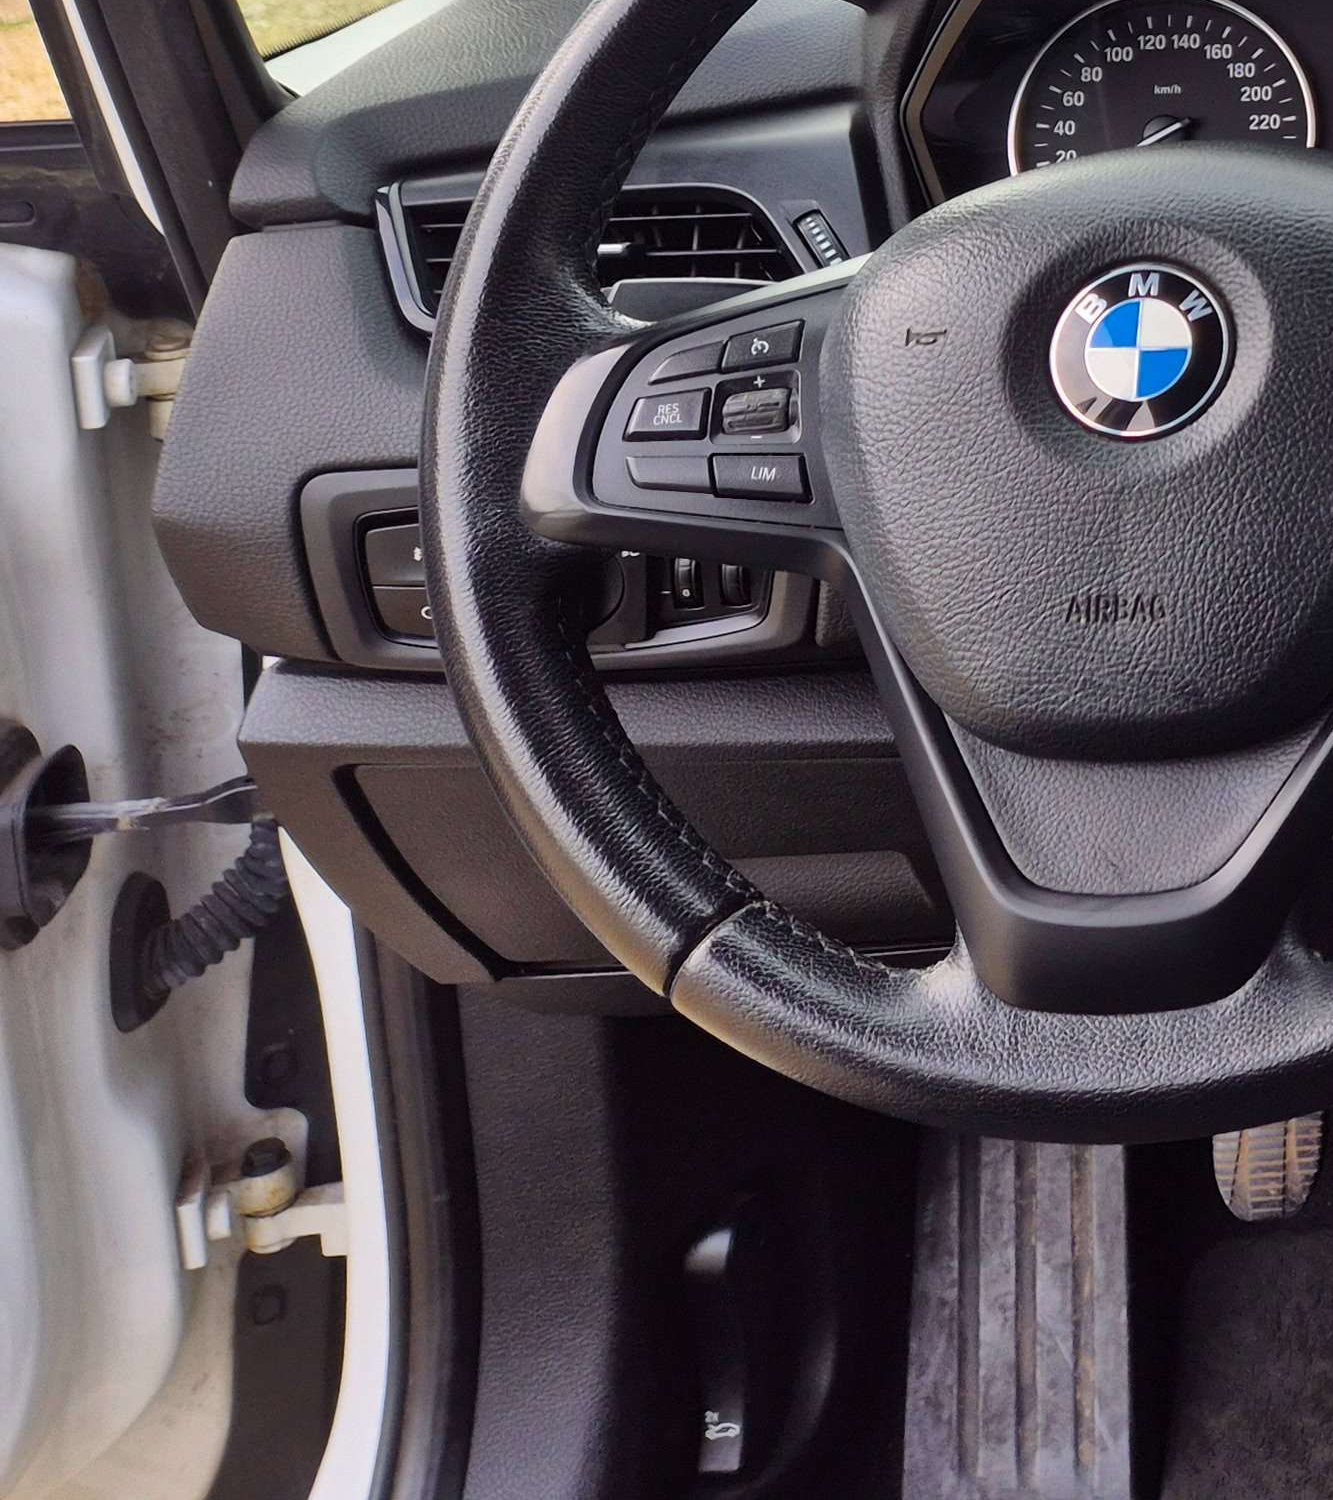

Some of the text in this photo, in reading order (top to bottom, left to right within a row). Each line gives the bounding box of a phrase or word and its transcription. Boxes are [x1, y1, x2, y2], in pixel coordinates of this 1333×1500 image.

[1137, 35, 1167, 50] 120
[1171, 33, 1200, 49] 140
[1104, 46, 1133, 62] 100
[1203, 44, 1233, 59] 160
[1080, 66, 1103, 82] 80
[1226, 62, 1256, 78] 180
[1154, 84, 1182, 95] km/h
[1240, 86, 1272, 101] 200
[1062, 91, 1085, 107] 60
[1053, 120, 1076, 136] 40
[1249, 114, 1281, 130] 220
[1074, 273, 1213, 324] BMW
[657, 403, 680, 415] RES
[653, 413, 682, 426] CNCL
[751, 466, 776, 482] LIM
[1065, 594, 1166, 623] AIRBAG
